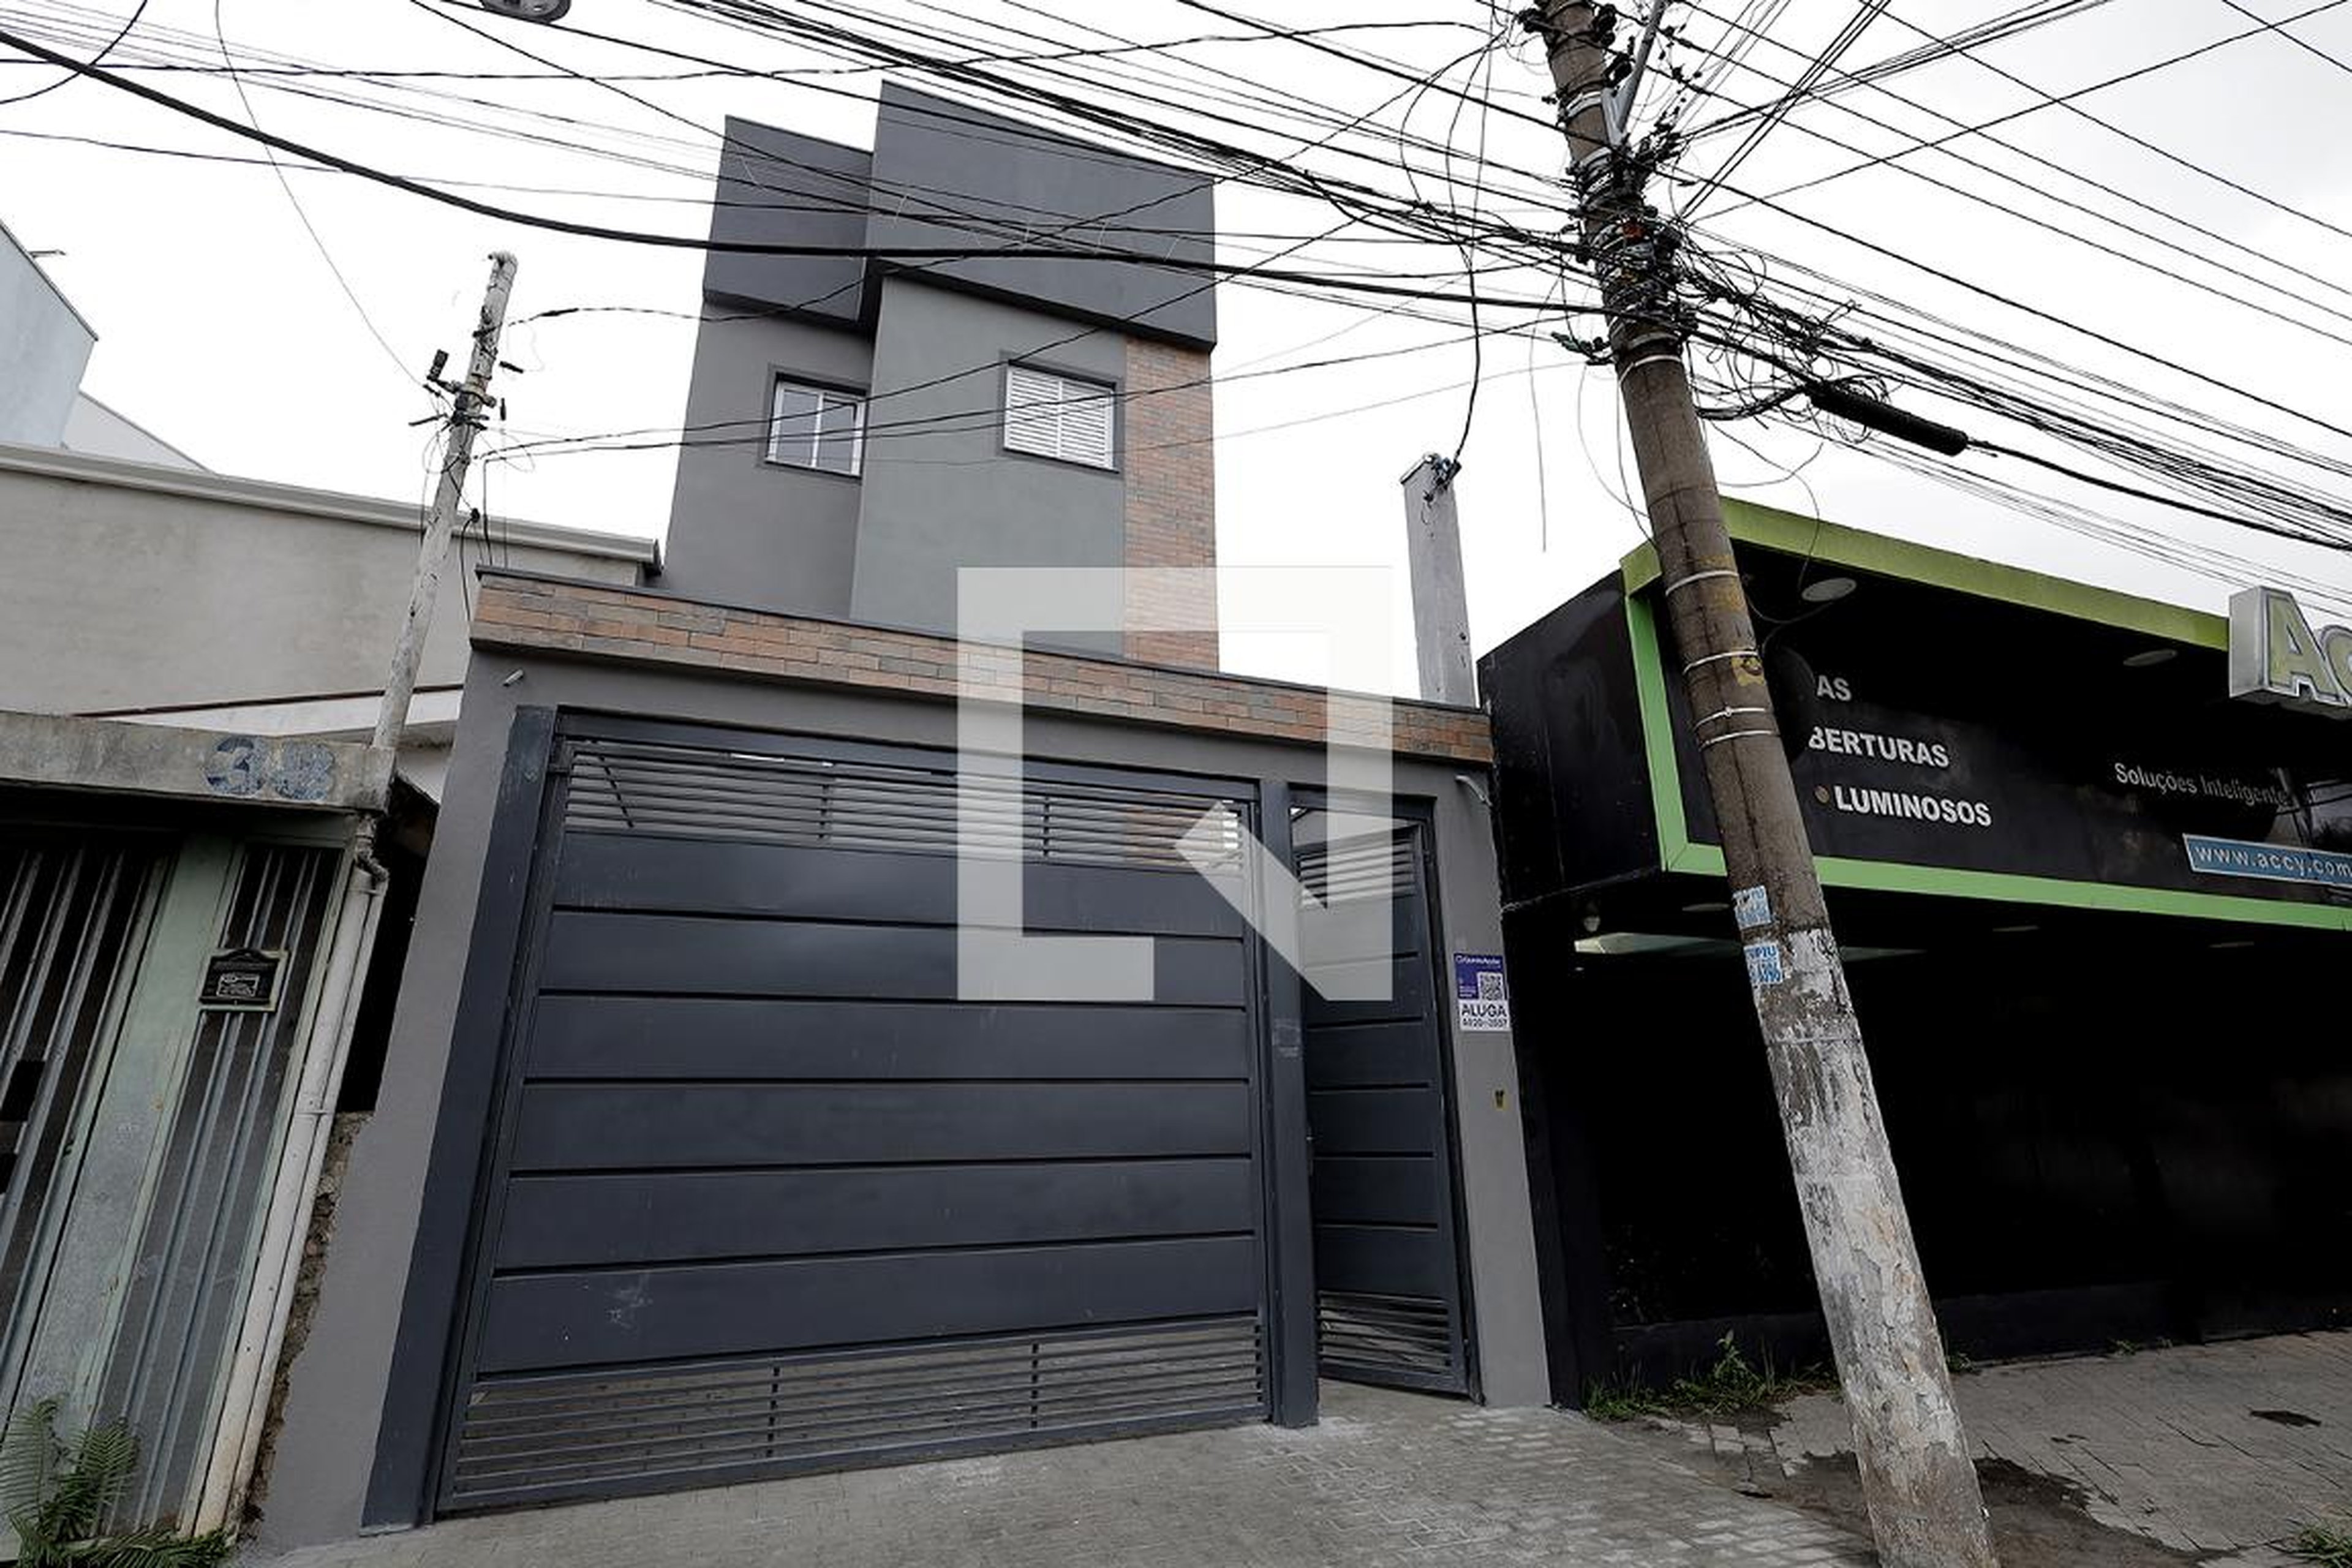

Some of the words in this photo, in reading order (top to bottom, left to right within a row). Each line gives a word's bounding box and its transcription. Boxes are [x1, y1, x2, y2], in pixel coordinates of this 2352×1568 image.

[2115, 763, 2198, 795] Soluções
[1834, 786, 1991, 827] LUMINOSOS
[2195, 846, 2352, 876] www.accy.com
[1461, 1004, 1507, 1017] ALUGA
